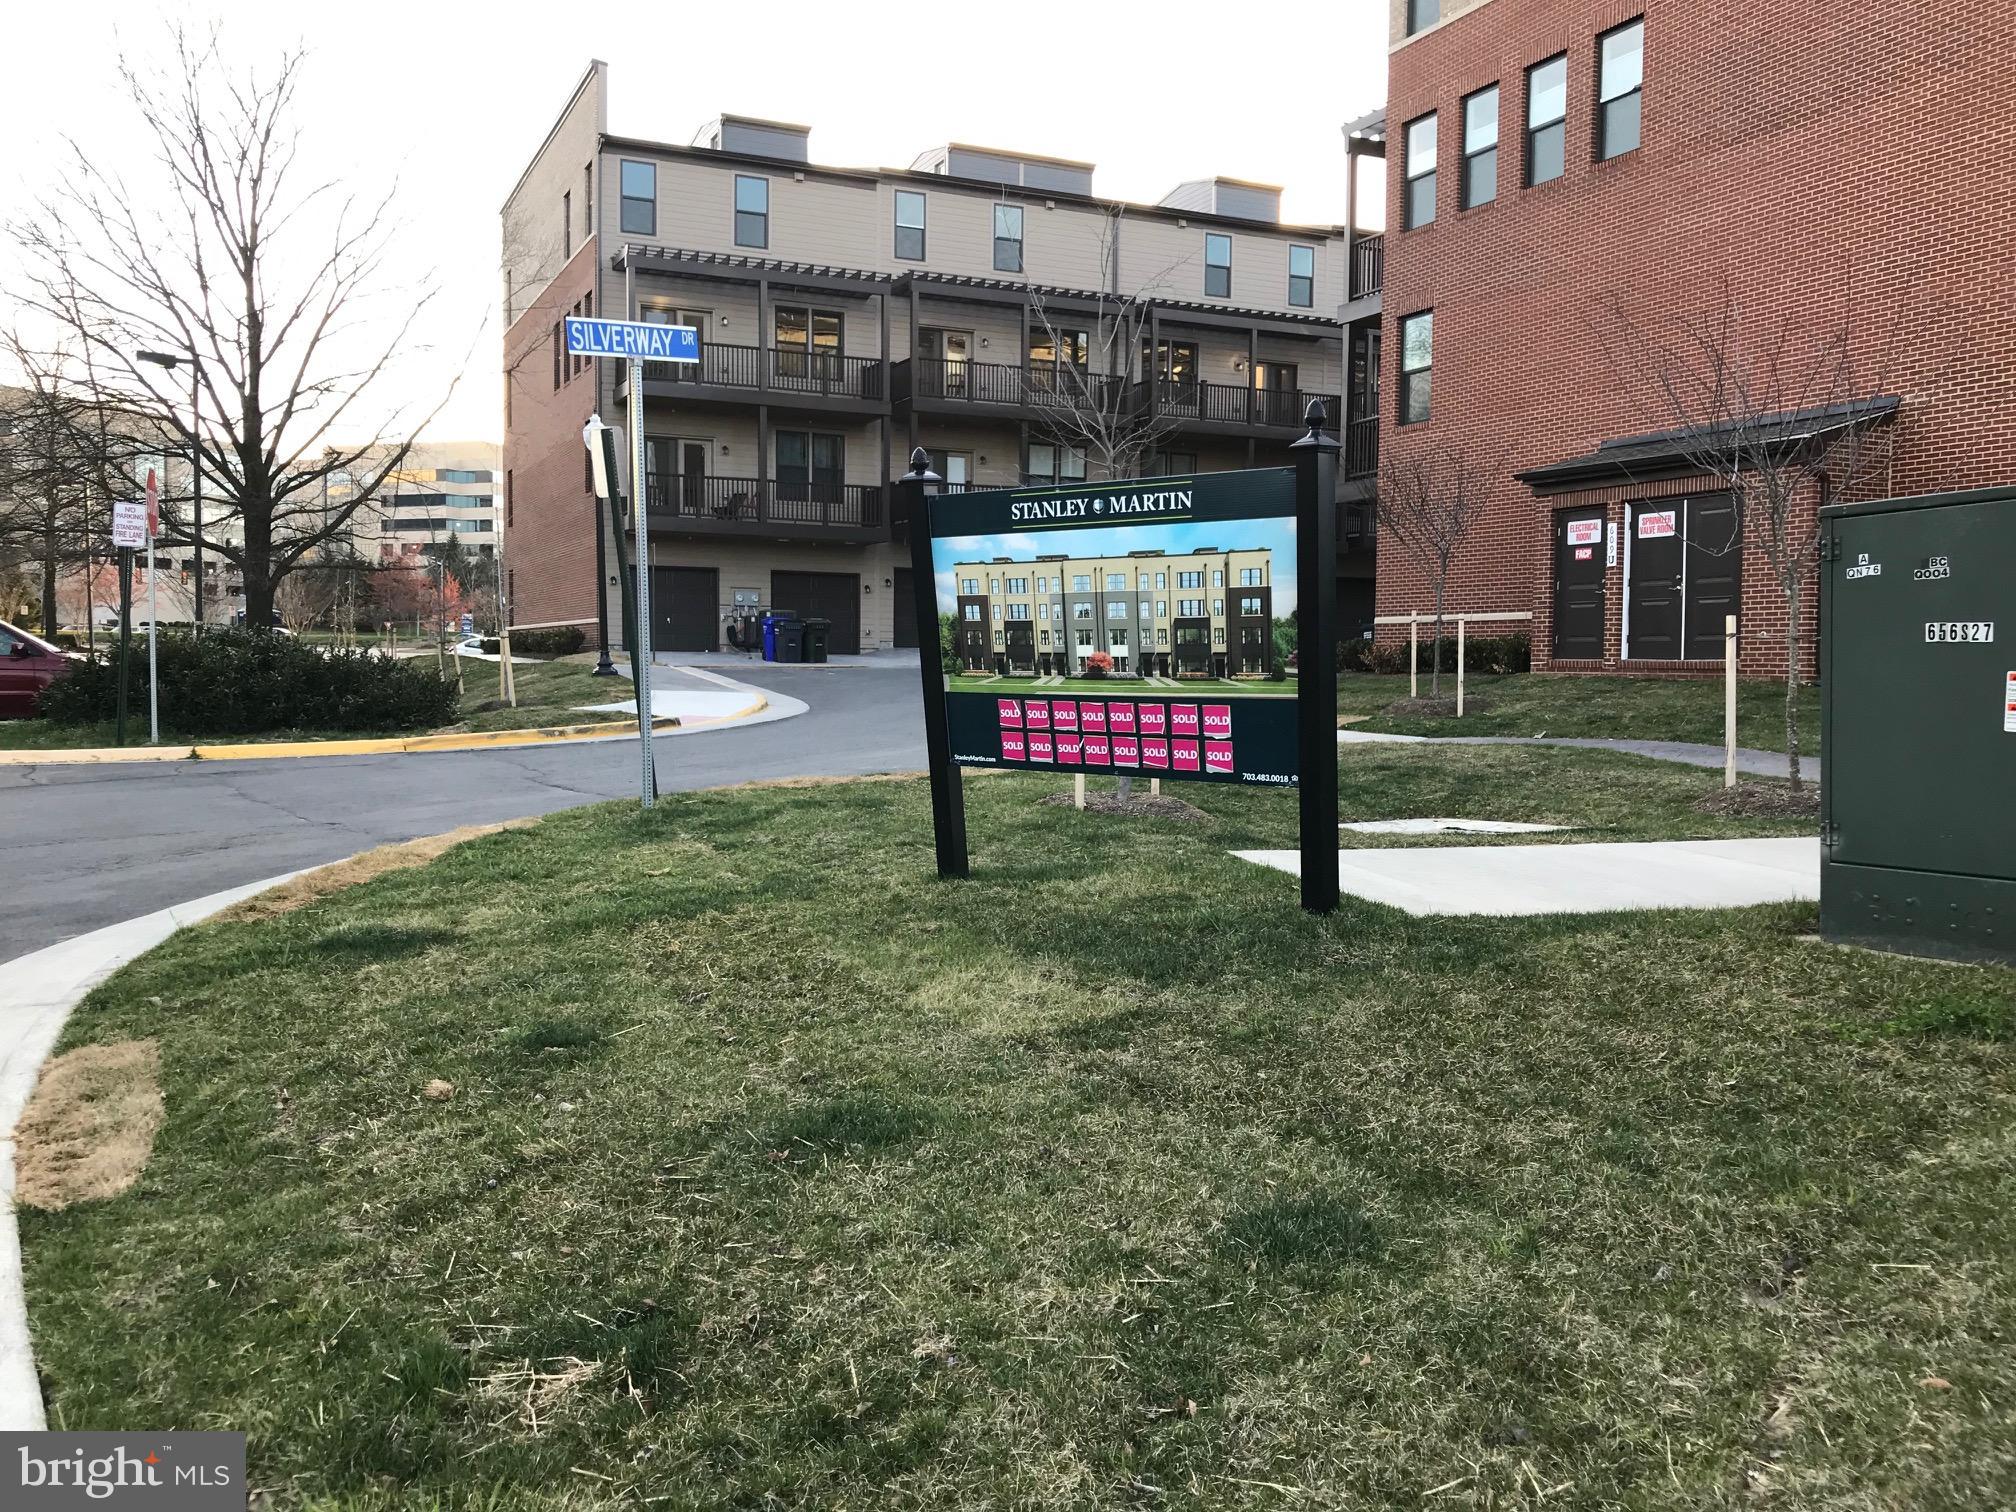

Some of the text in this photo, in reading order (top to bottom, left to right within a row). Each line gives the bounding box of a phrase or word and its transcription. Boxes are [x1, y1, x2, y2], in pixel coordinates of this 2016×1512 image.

[571, 321, 695, 356] SILVERWAY DR
[1011, 490, 1193, 520] STANLEY MARTIN
[1569, 522, 1599, 532] ELECTRICAL
[1640, 525, 1656, 535] VALVE
[1575, 532, 1592, 542] ROOM
[1860, 555, 1868, 563] A
[1930, 557, 1947, 567] BC
[1847, 566, 1880, 578] QN76
[1928, 623, 1991, 641] 656S27
[1000, 709, 1020, 718] SOLD
[1027, 710, 1048, 719] SOLD
[1054, 710, 1076, 720] SOLD
[1082, 712, 1104, 721] SOLD
[1110, 712, 1133, 722] SOLD
[1141, 714, 1164, 723] SOLD
[1173, 715, 1197, 724] SOLD
[1204, 716, 1229, 725] SOLD
[1003, 741, 1023, 750] SOLD
[1030, 742, 1051, 752] SOLD
[1058, 743, 1079, 753] SOLD
[1085, 745, 1108, 755] SOLD
[1114, 746, 1137, 756] SOLD
[1144, 747, 1167, 758] SOLD
[1173, 749, 1197, 759] SOLD
[1207, 751, 1231, 761] SOLD
[954, 753, 996, 762] StanleyMartin.com
[1242, 772, 1289, 783] 703.483.0018
